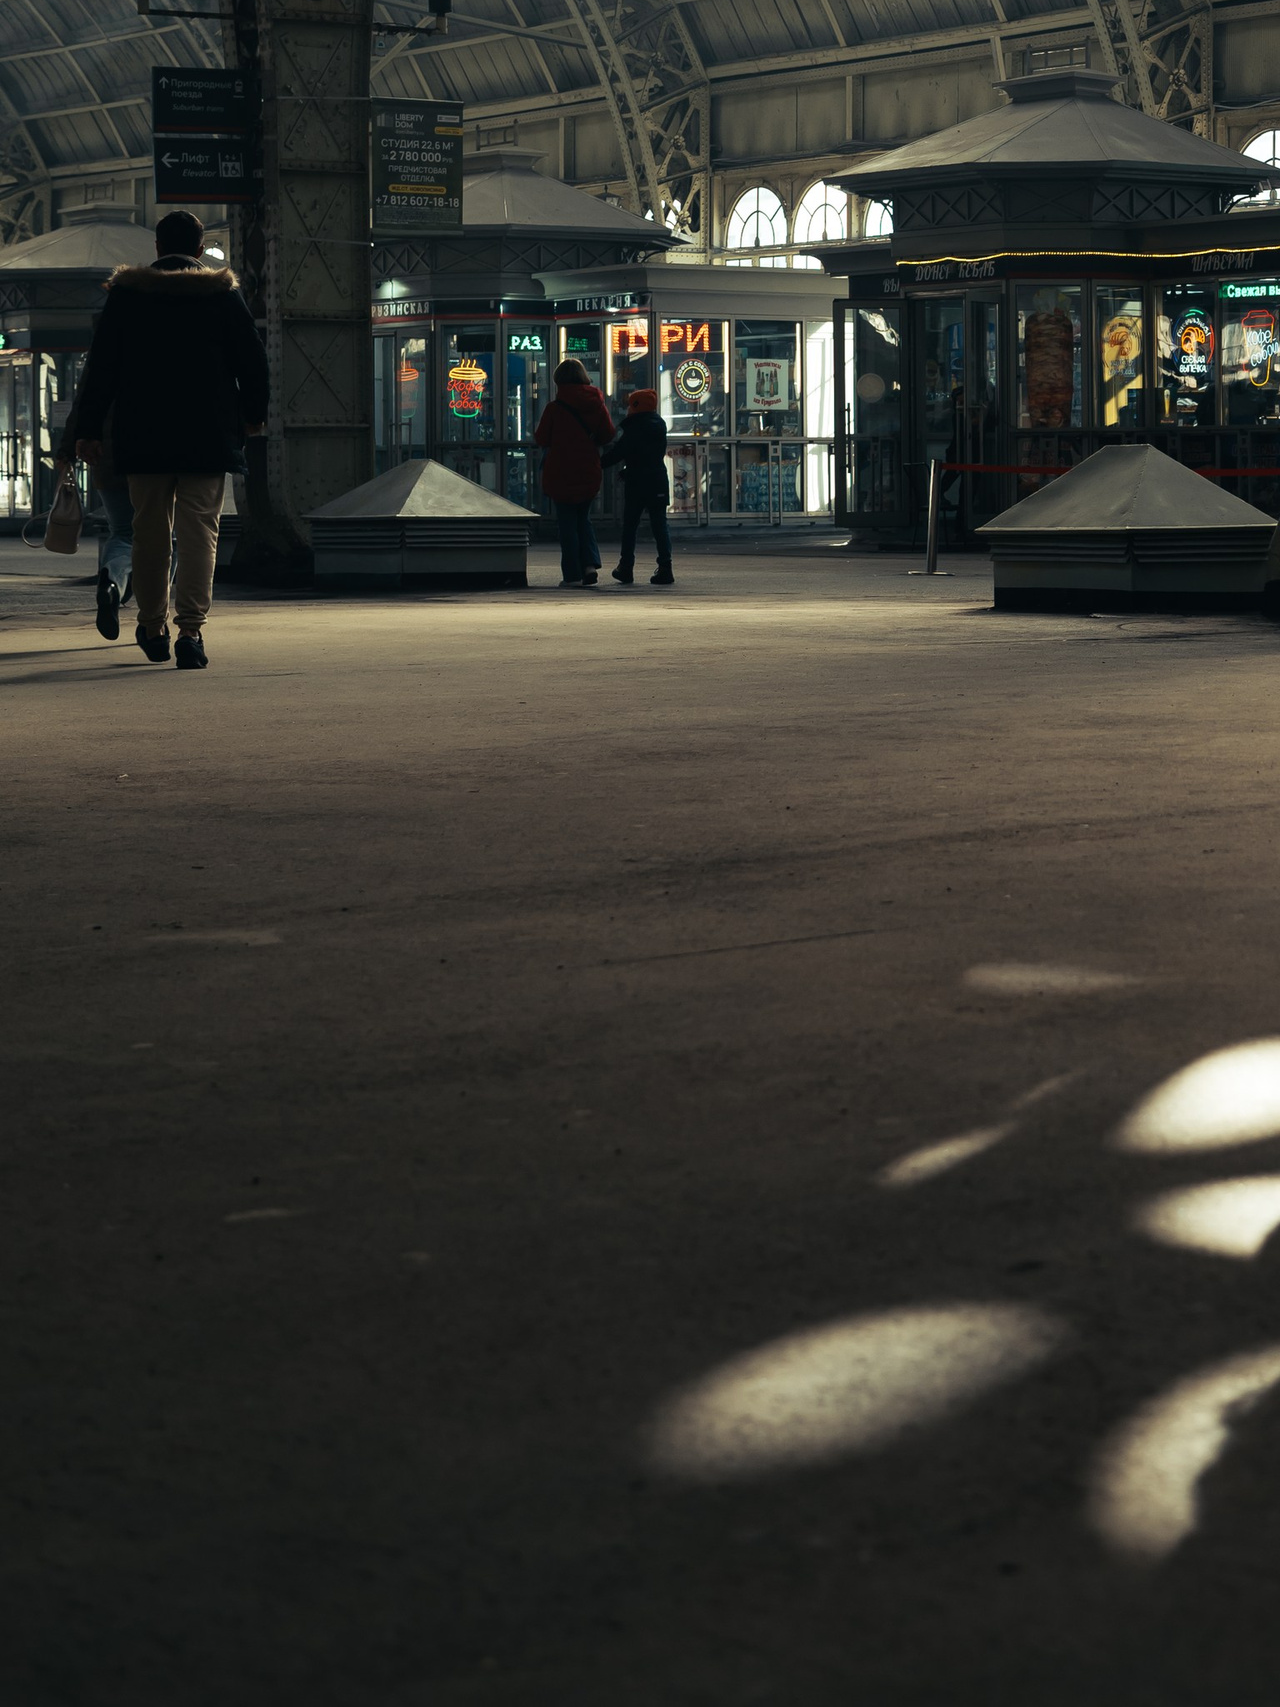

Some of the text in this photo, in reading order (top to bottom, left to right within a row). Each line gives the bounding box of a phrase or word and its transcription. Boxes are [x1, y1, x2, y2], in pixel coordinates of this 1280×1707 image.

[170, 79, 232, 89] Пригородные
[171, 90, 202, 98] поезда
[206, 105, 224, 113] trains
[395, 113, 424, 122] LIBERTY
[381, 139, 419, 149] СТУДИЯ
[421, 141, 440, 150] 22,6
[181, 153, 210, 164] Лифт
[389, 151, 397, 161] 2
[399, 151, 419, 161] 780
[421, 152, 441, 162] 000
[182, 169, 217, 178] Elevator
[388, 165, 447, 175] ПРЕДЧИСТОВАЯ
[400, 174, 435, 183] ОТДЕЛКА
[375, 195, 460, 208] +7 812 607-18-18
[1191, 252, 1255, 273] ШАВЕРМА
[958, 260, 996, 279] КЕБАБ
[1227, 284, 1267, 298] Свежая
[576, 295, 631, 311] ПЕКАРНЯ
[371, 302, 430, 318] РУЗИНСКАЯ
[1246, 328, 1272, 346] кофе
